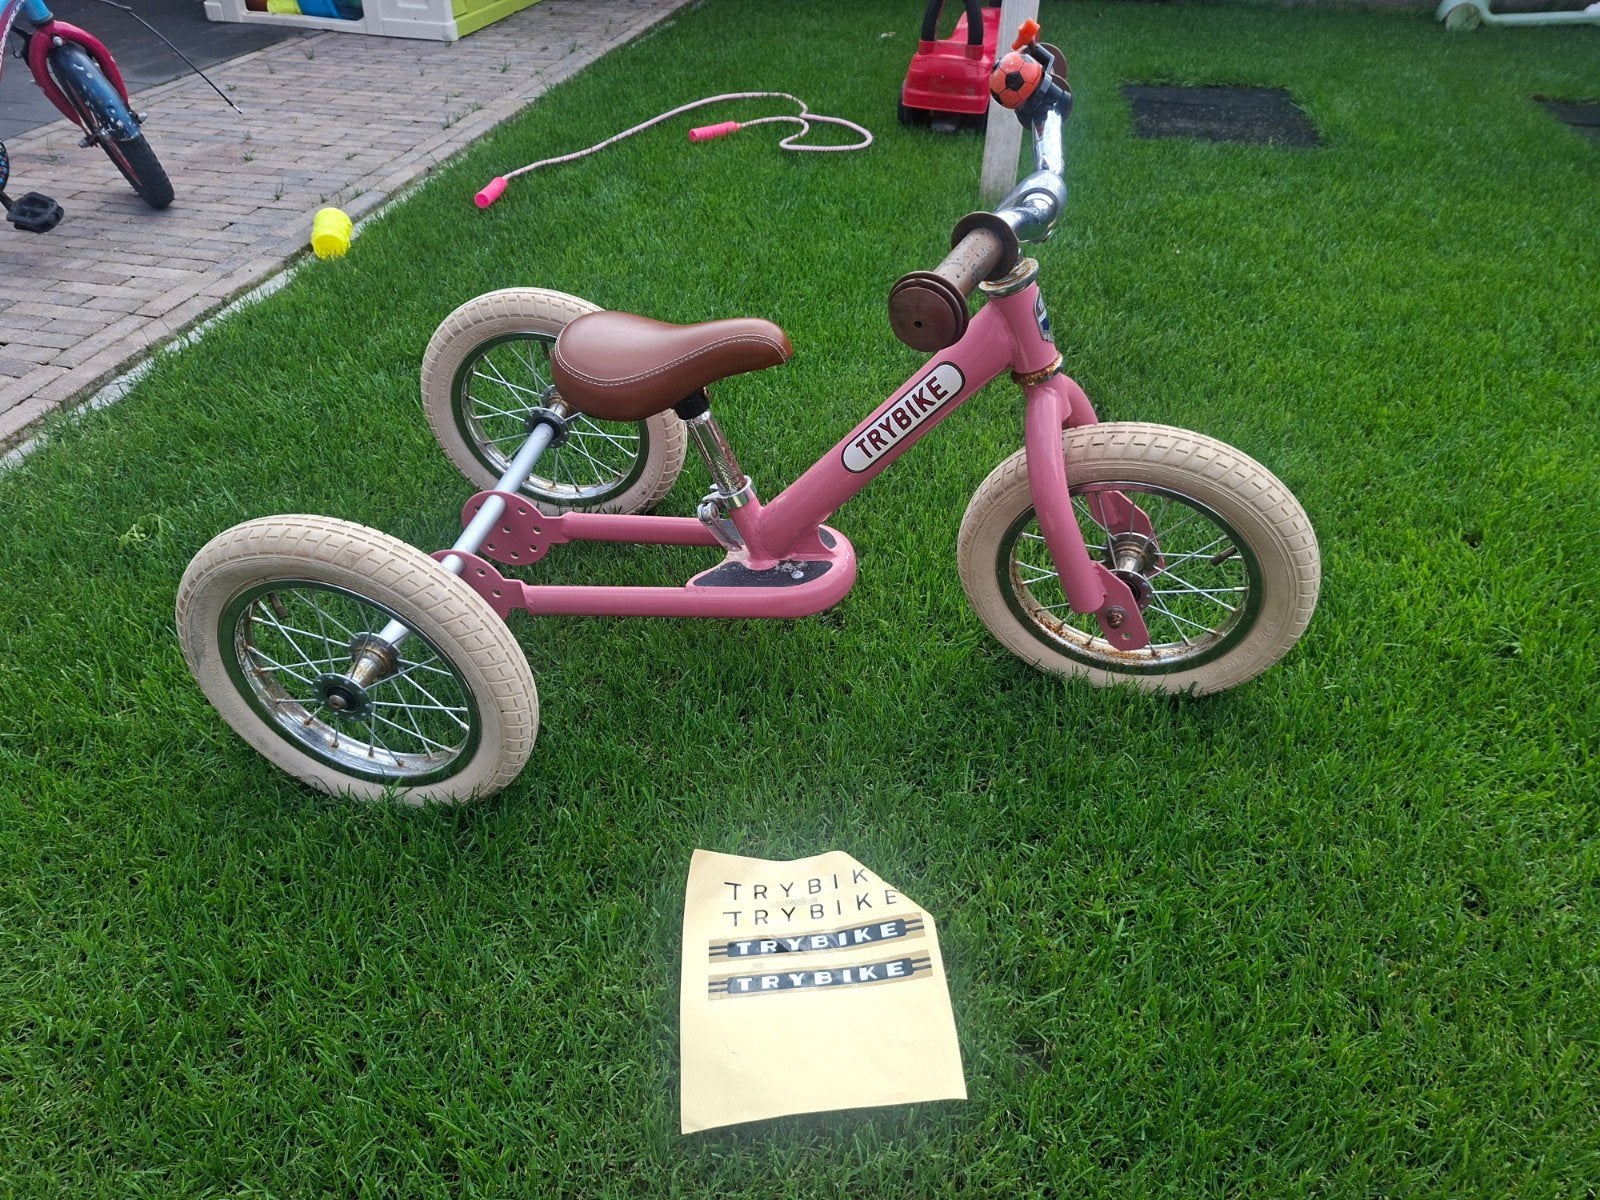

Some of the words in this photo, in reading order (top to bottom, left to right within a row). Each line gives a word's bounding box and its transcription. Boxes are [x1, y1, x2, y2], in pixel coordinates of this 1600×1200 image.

[855, 376, 949, 459] TRYBIKE
[724, 868, 869, 900] TRYBIK
[723, 889, 899, 926] TRYBIKE
[736, 923, 898, 954] TRYBIKE
[736, 961, 904, 991] TRYBIKE
